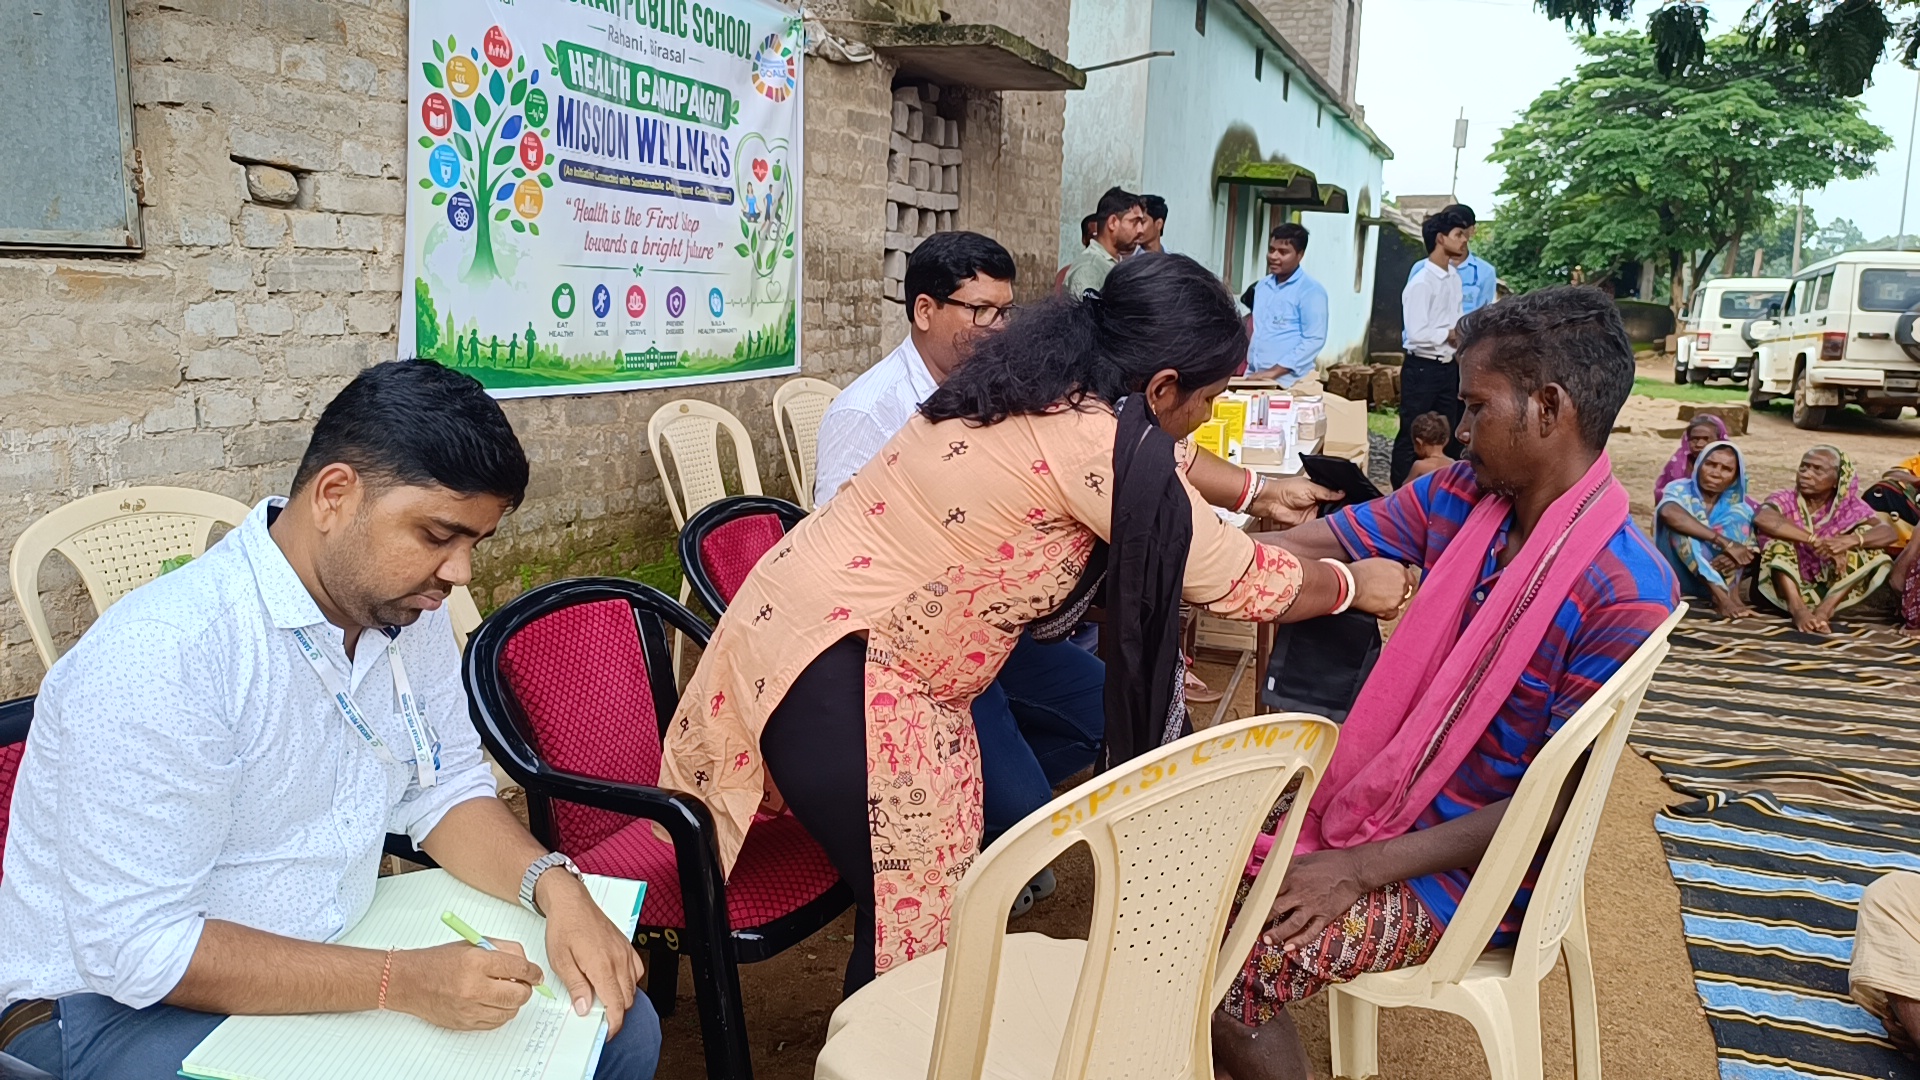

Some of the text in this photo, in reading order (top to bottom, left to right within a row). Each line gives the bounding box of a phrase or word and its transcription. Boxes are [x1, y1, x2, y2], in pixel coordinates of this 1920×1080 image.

[608, 25, 685, 64] Rahani, Birasal
[625, 0, 751, 60] PUBLIC SCHOOL
[568, 49, 725, 124] HEALTH CAMPAIGN
[557, 95, 629, 160] MISSION
[612, 205, 620, 225] is
[625, 206, 641, 227] the
[646, 207, 679, 230] First
[584, 230, 627, 254] towards
[631, 240, 638, 254] a
[642, 235, 683, 263] bright
